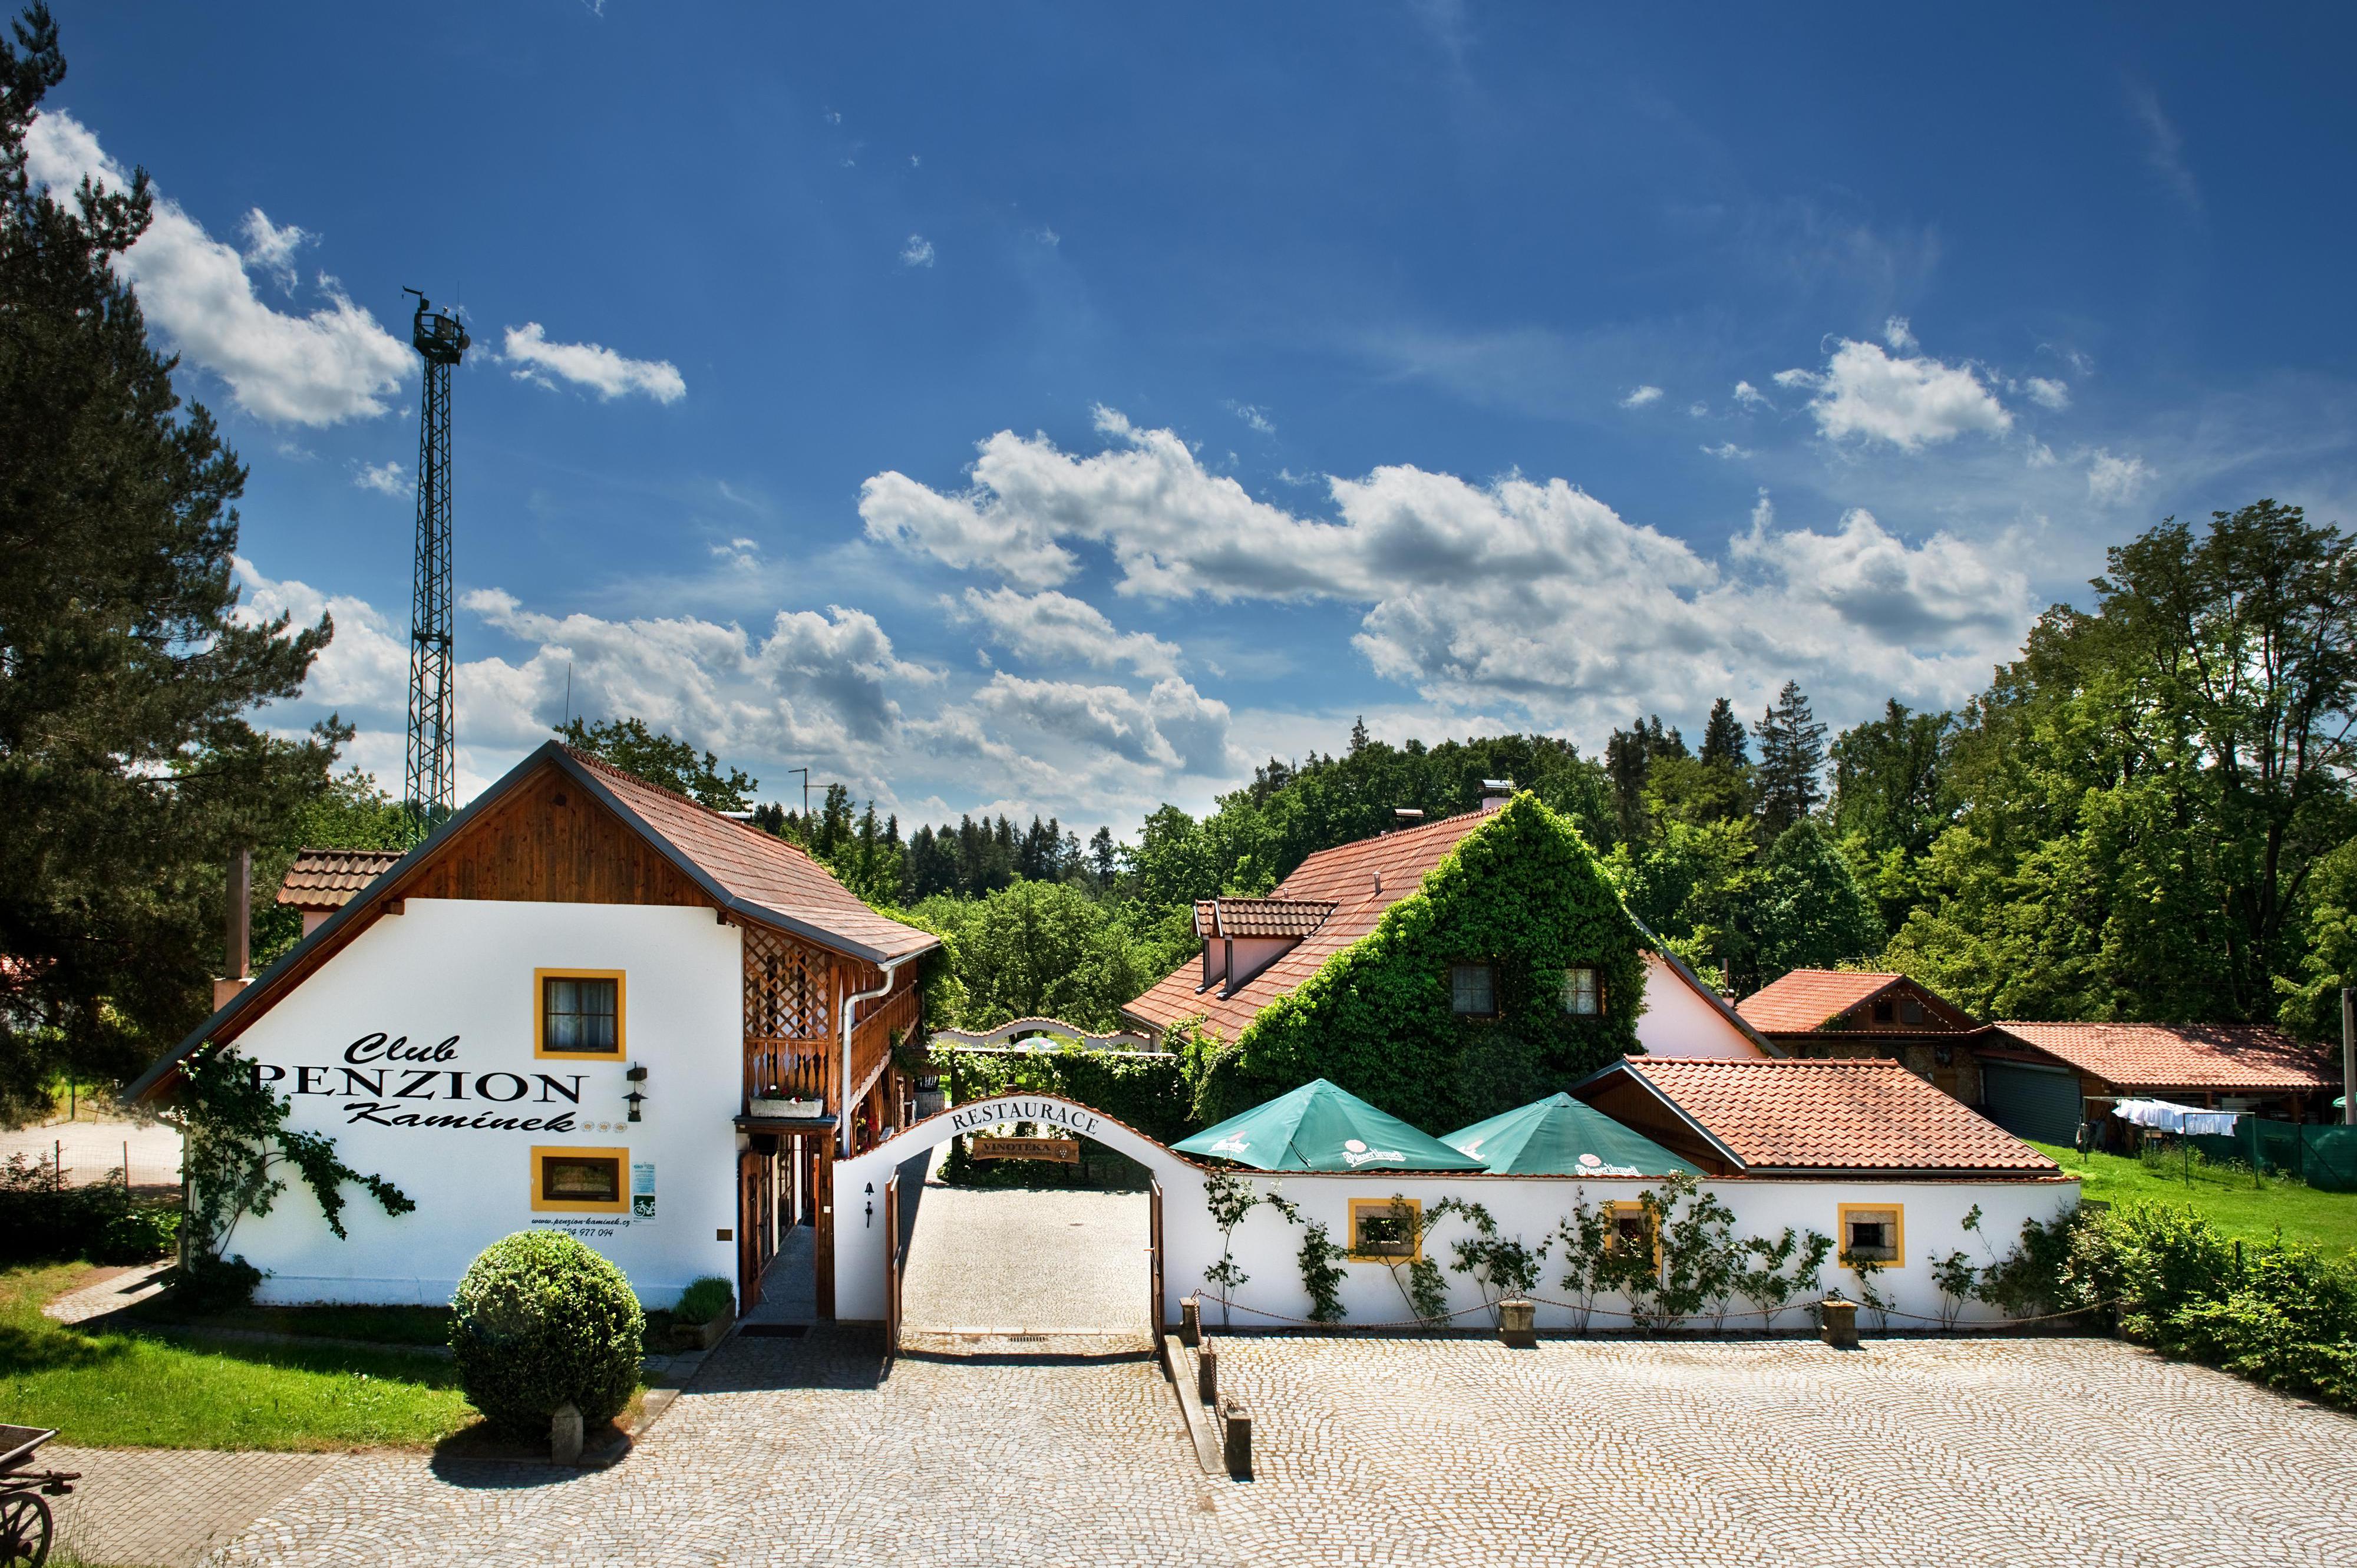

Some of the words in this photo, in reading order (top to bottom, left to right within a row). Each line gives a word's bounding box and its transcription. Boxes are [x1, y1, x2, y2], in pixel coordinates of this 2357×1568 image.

[344, 1032, 460, 1064] Club
[250, 1065, 590, 1104] PENZION
[343, 1102, 577, 1133] Kamínek
[950, 1102, 1100, 1135] RESTAURACE
[983, 1141, 1051, 1151] VINOTÉKA
[579, 1228, 596, 1236] 977
[598, 1229, 614, 1237] 094
